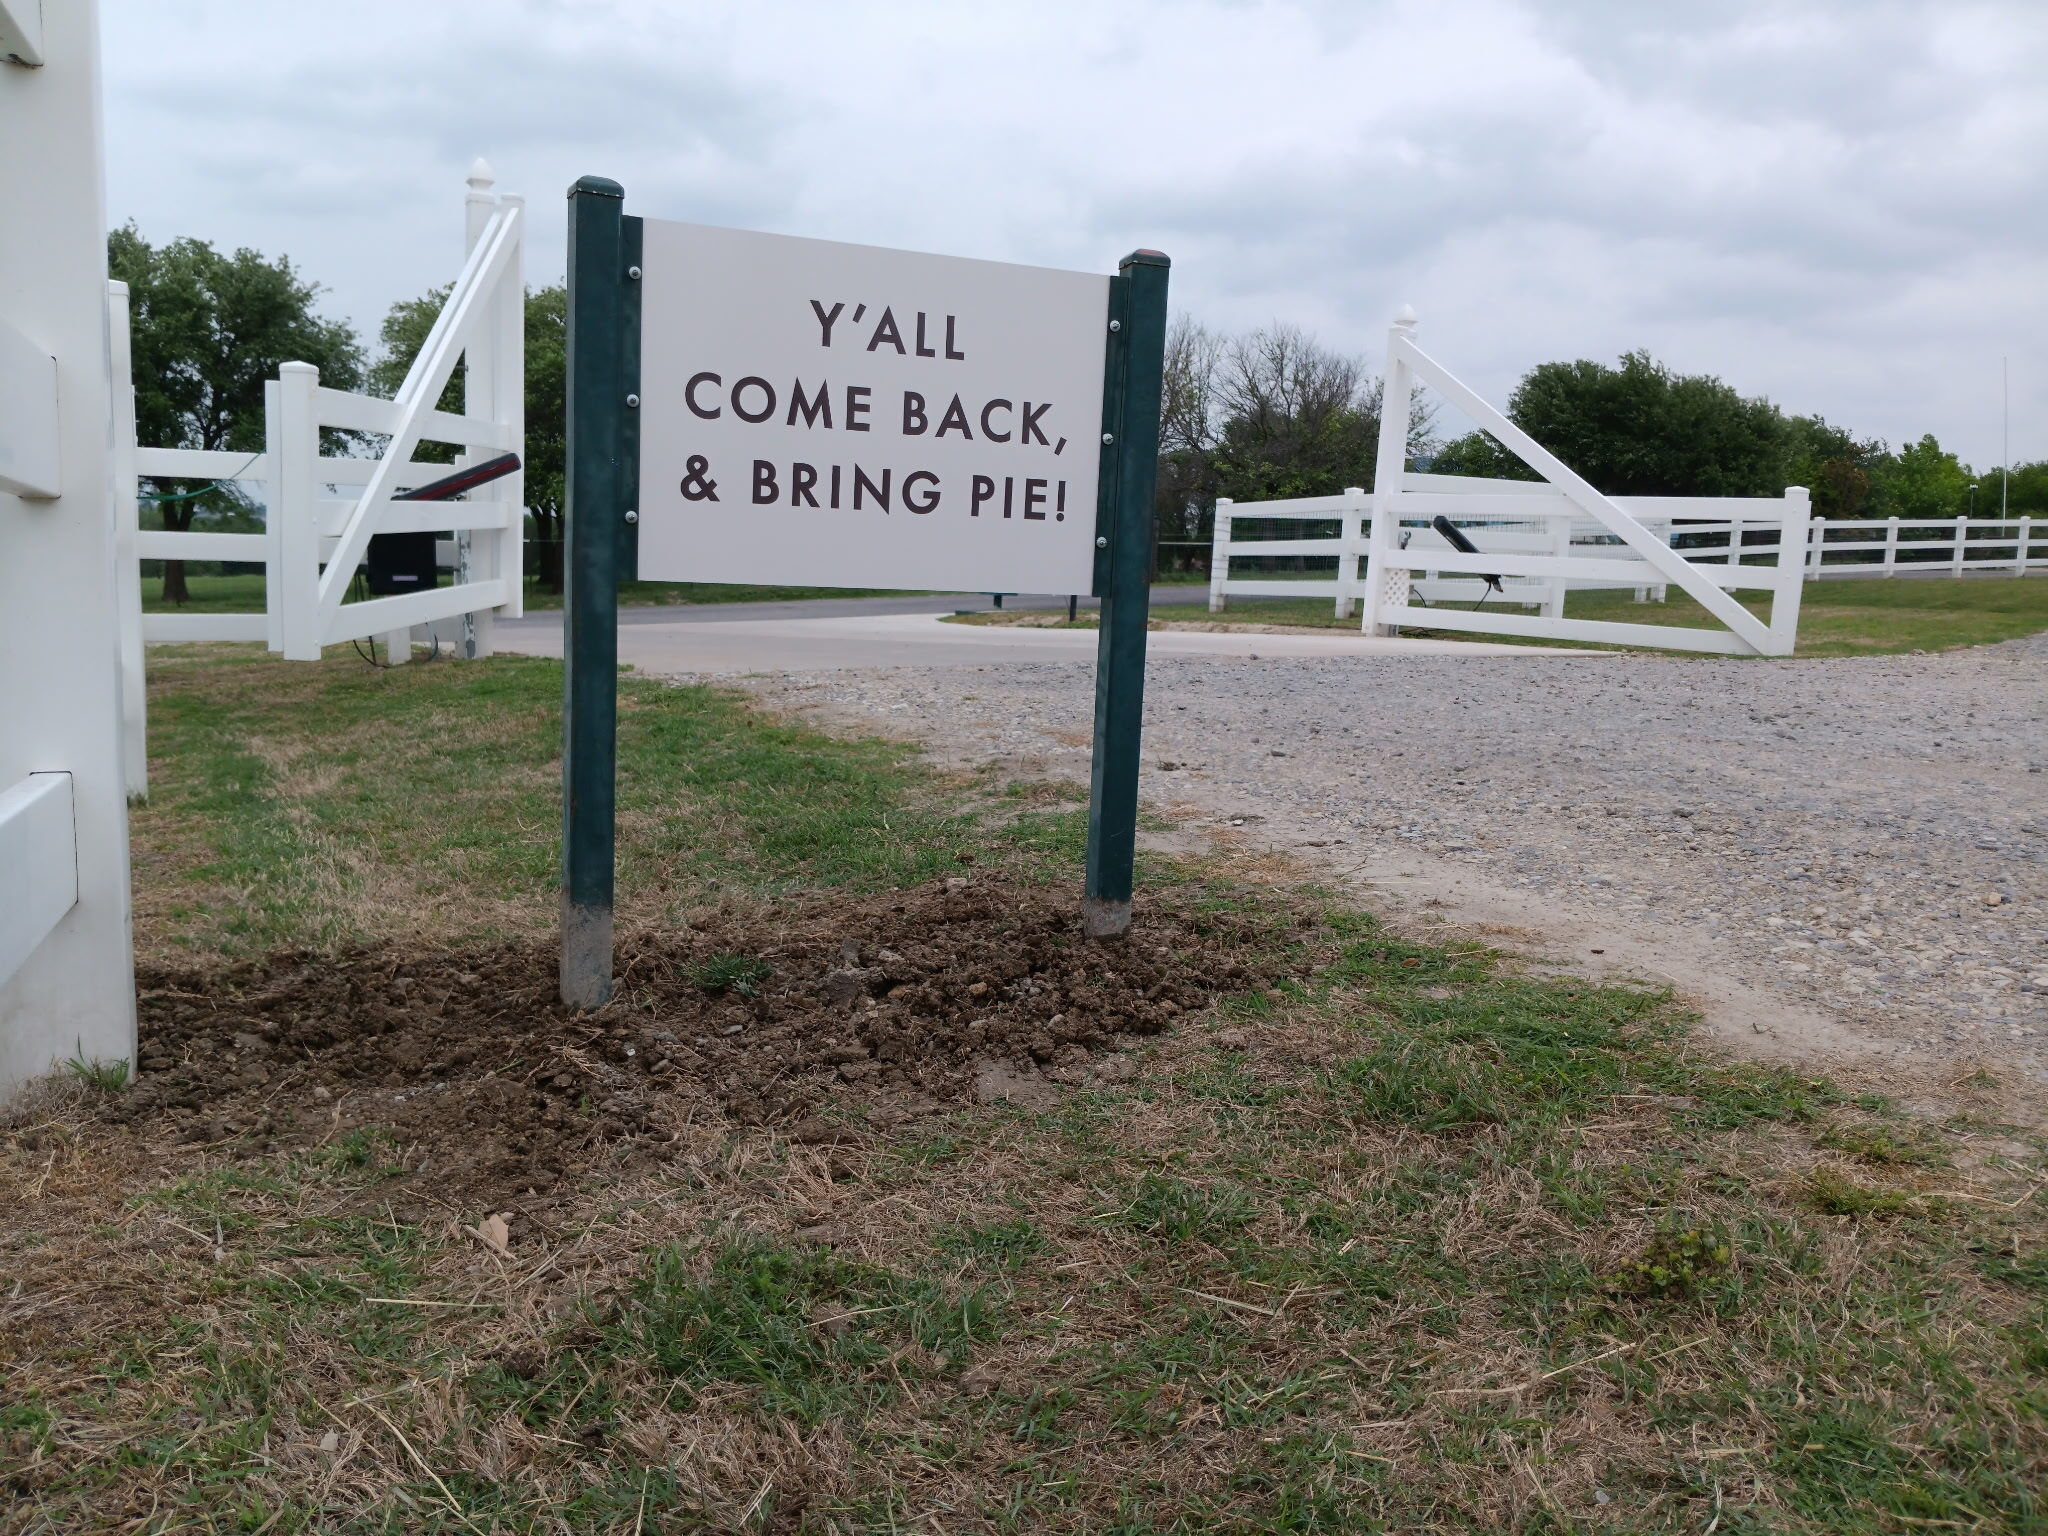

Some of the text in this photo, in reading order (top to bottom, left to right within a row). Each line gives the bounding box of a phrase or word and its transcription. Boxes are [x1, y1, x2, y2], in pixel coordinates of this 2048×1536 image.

[810, 299, 965, 361] Y'ALL
[684, 371, 1068, 456] COME BACK,
[680, 454, 1067, 523] & BRING PIE!
